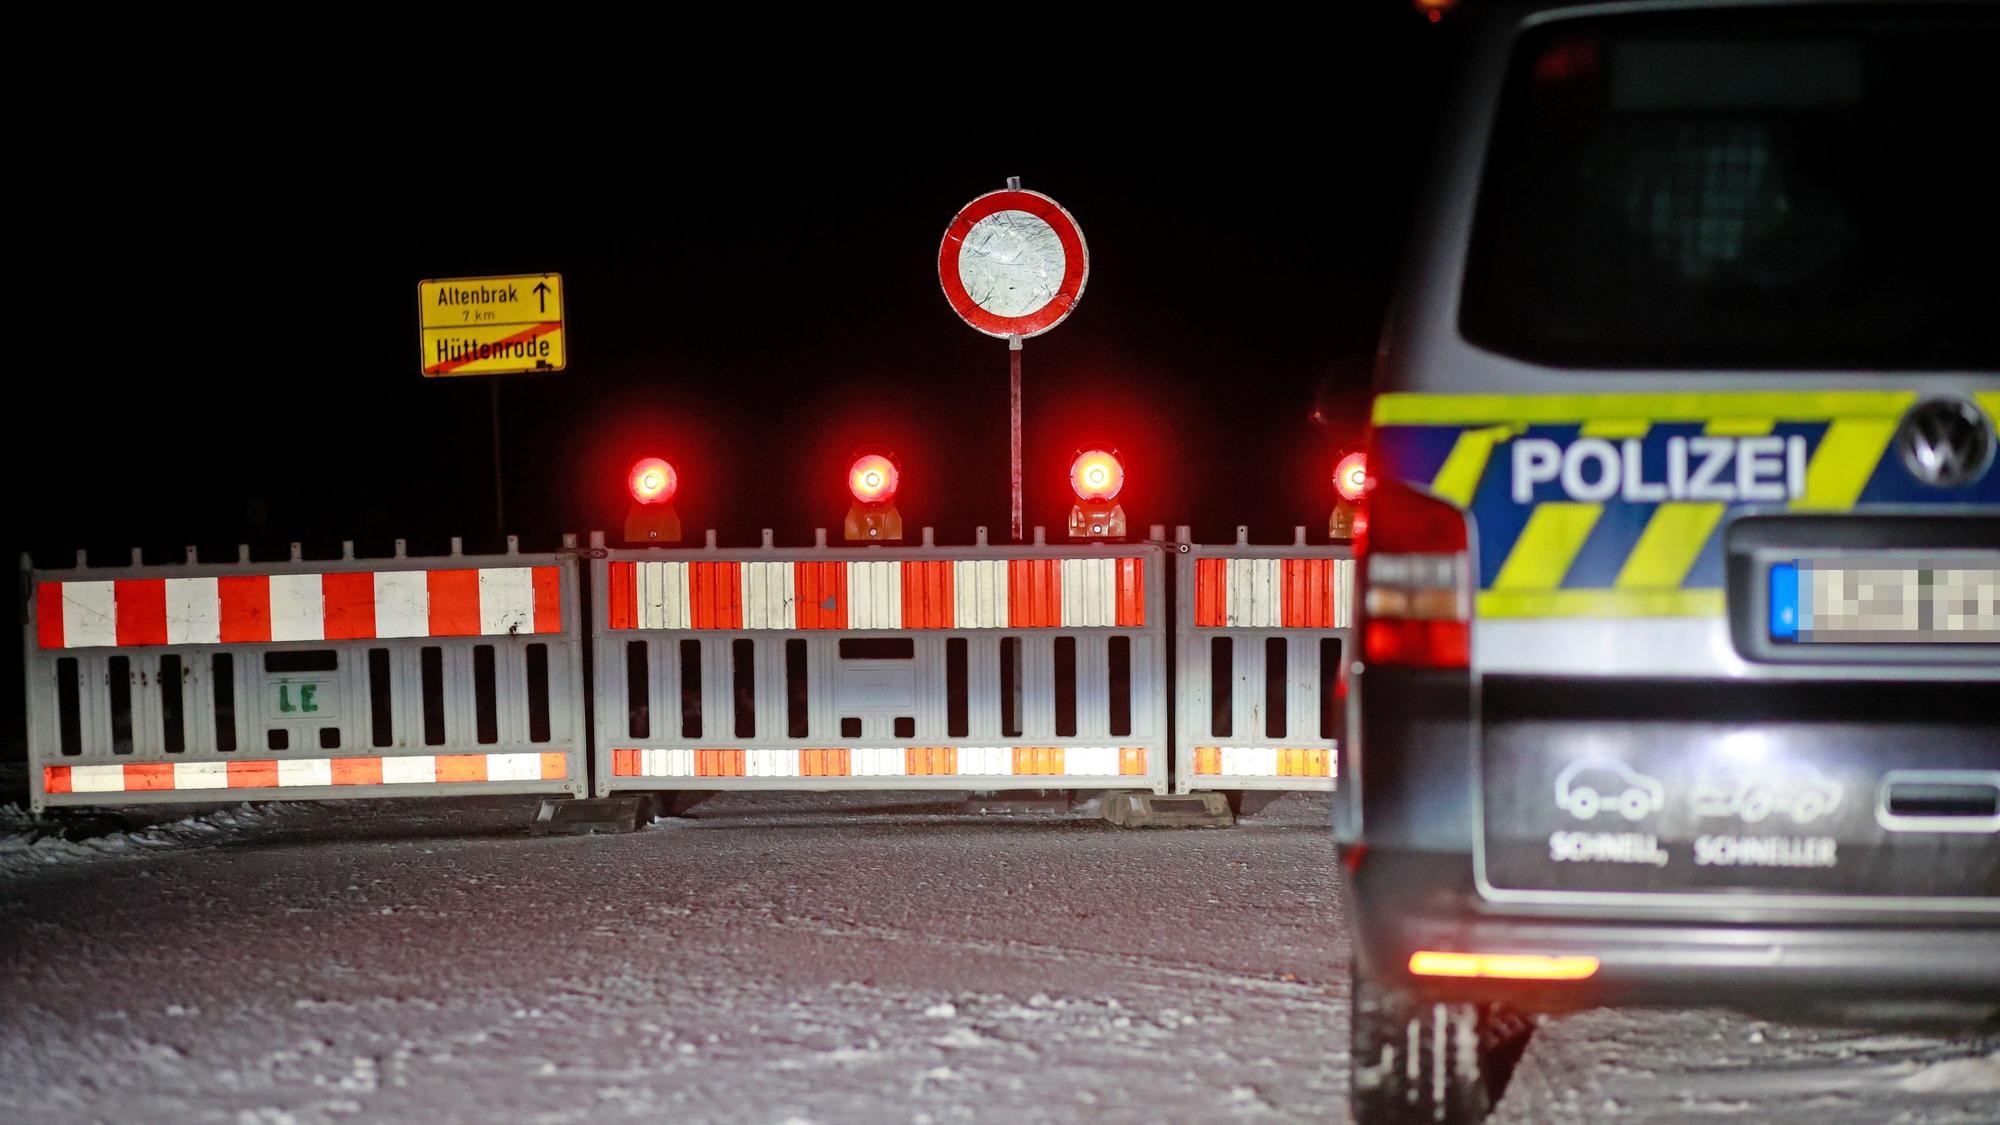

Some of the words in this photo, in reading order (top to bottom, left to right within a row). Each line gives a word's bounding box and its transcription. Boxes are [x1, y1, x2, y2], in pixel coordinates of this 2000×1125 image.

[438, 284, 518, 306] Altenbrak
[462, 310, 470, 321] 7
[475, 310, 495, 322] km
[437, 334, 550, 362] Hüttenrode
[1511, 434, 1807, 503] POLIZEI
[1693, 834, 1838, 868] SCHNELLER
